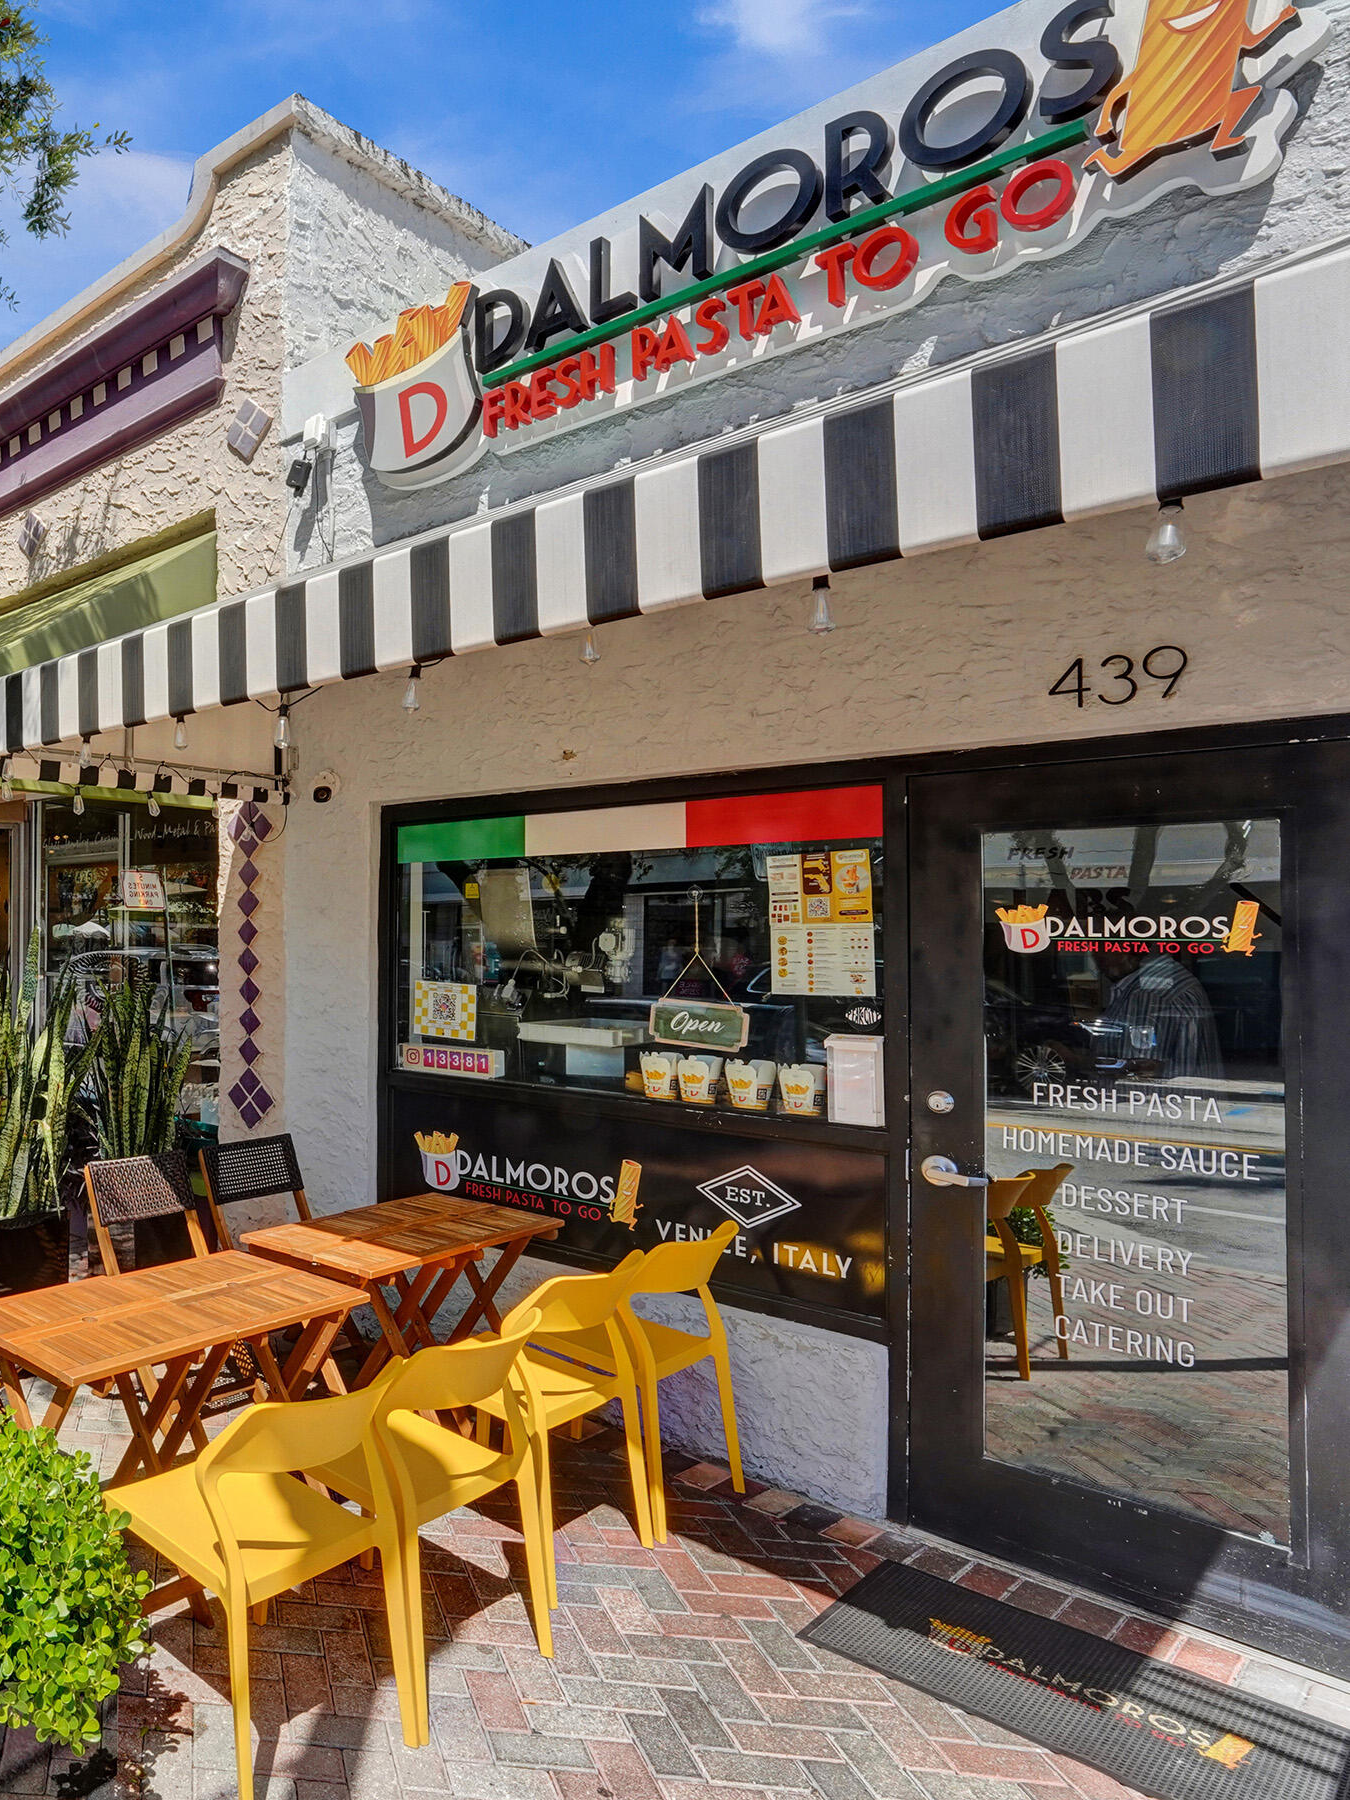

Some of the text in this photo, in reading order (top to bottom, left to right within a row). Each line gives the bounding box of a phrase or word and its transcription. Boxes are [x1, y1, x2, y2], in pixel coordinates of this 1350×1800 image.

[474, 0, 1123, 375] DALMOROS
[483, 159, 1077, 439] FRESH PASTA TO GO
[398, 382, 447, 458] D
[1048, 645, 1188, 708] 439
[1070, 865, 1128, 880] PASTA
[1021, 929, 1039, 949] D
[1046, 916, 1229, 938] DALMOROS
[1057, 941, 1215, 954] FRESH PASTA TO GO
[671, 1011, 726, 1034] Open
[427, 1052, 487, 1070] 13381
[1033, 1082, 1222, 1124] FRESH PASTA
[435, 1161, 450, 1186] D
[1003, 1126, 1261, 1181] HOMEMADE SAUCE
[456, 1149, 616, 1204] DALMOROS
[725, 1186, 771, 1208] EST.
[465, 1182, 601, 1221] FRESH PASTA TO GO
[1062, 1183, 1188, 1224] DESSERT
[773, 1242, 852, 1279] ITALY
[1057, 1231, 1193, 1277] DELIVERY
[1056, 1274, 1195, 1324] TAKE OUT
[1055, 1315, 1196, 1368] CATERING
[981, 1644, 1210, 1746] DALMOROS
[1115, 1713, 1142, 1729] TO
[1150, 1729, 1186, 1748] GO
